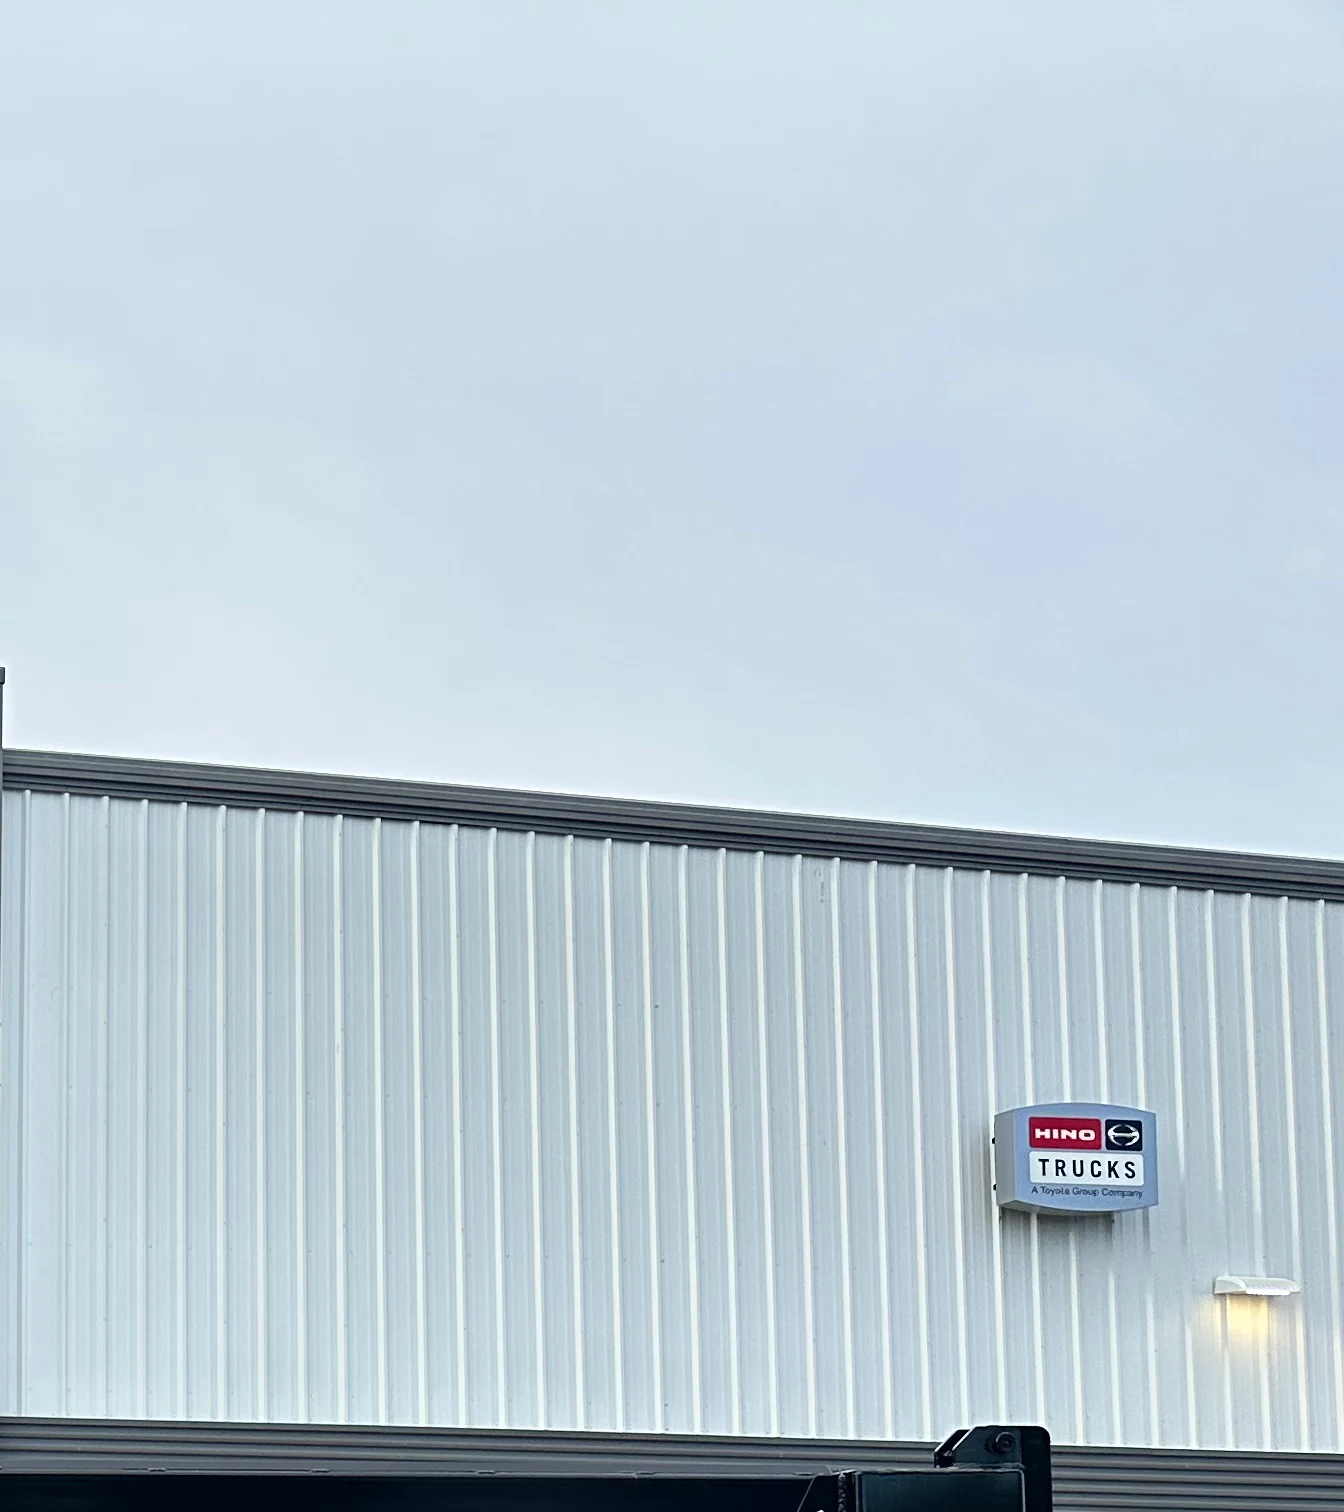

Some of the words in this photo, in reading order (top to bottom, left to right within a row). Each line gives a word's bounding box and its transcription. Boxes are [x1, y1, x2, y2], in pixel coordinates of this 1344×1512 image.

[1034, 1128, 1096, 1141] HINO
[1038, 1158, 1136, 1179] TRUCKS
[1031, 1186, 1038, 1194] A
[1041, 1186, 1070, 1196] Toyota
[1072, 1188, 1099, 1197] Group
[1101, 1188, 1144, 1199] Company
